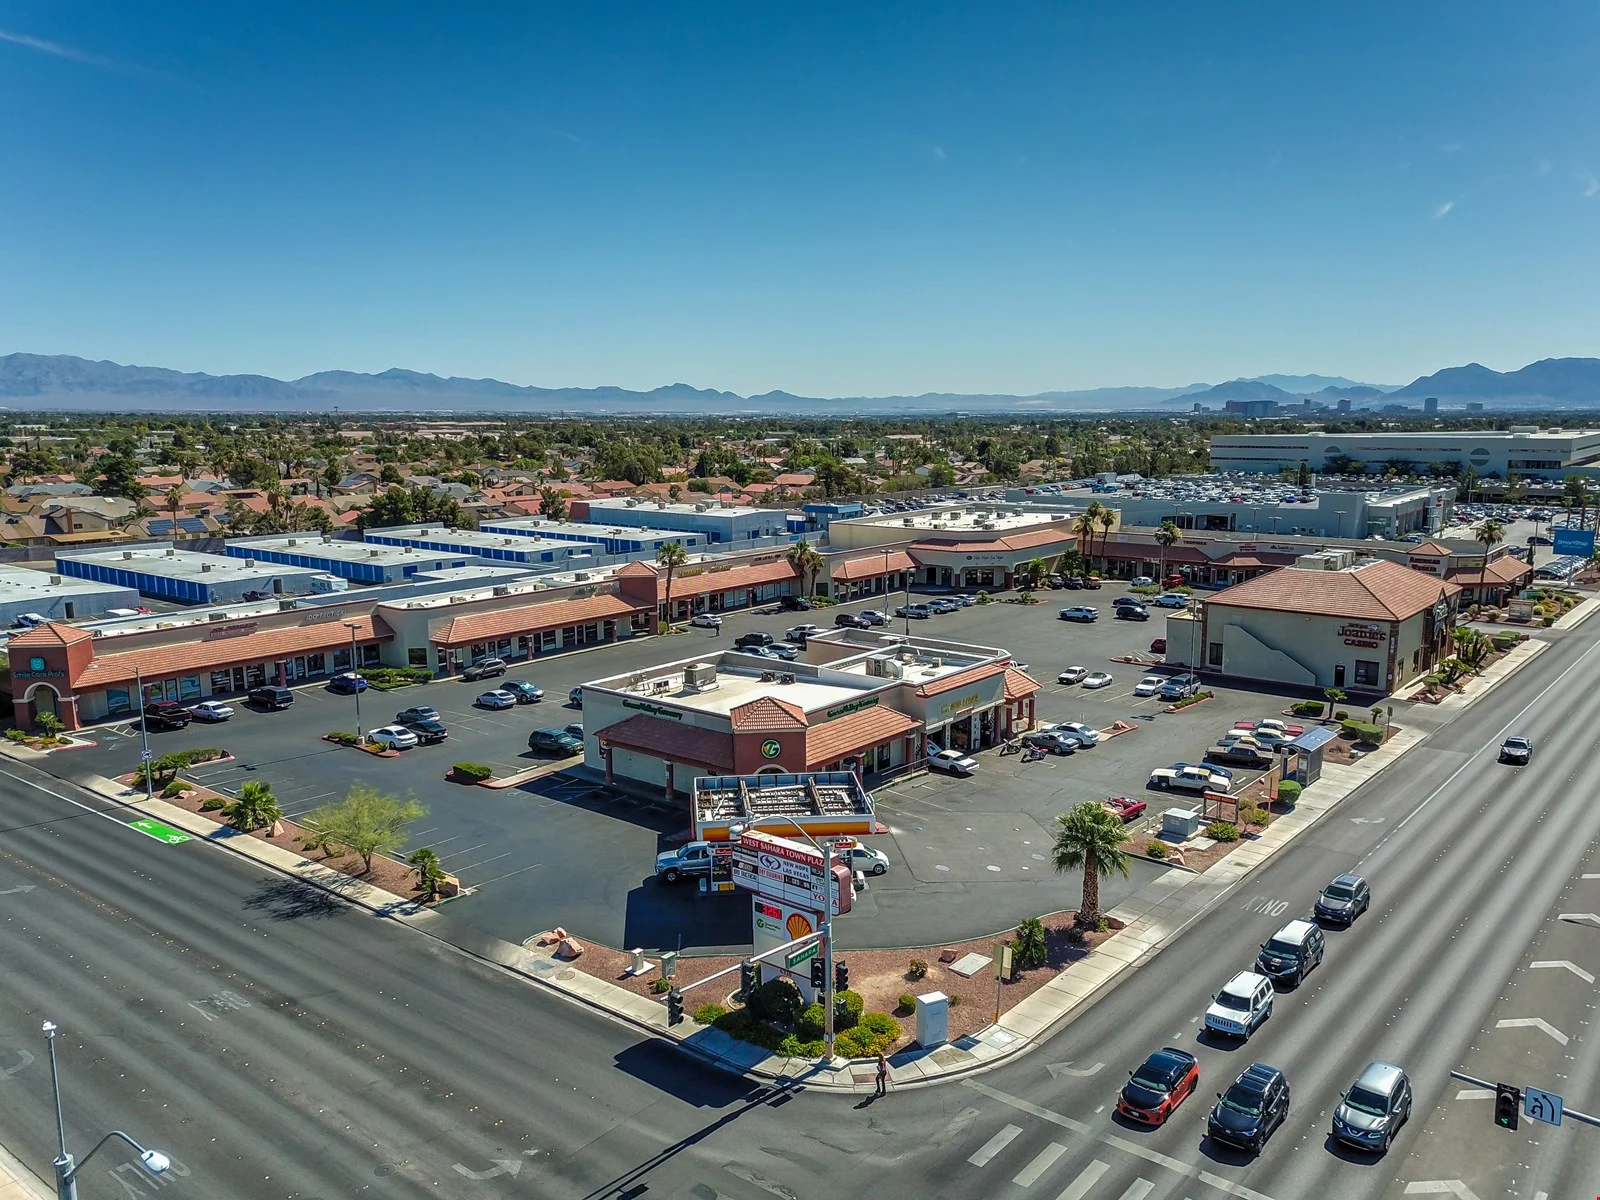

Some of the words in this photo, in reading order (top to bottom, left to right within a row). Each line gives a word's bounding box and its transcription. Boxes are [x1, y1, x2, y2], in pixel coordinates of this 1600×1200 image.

[742, 837, 759, 848] WEST
[760, 842, 785, 855] SAHARA
[785, 849, 807, 861] TOWN
[807, 855, 825, 867] PLAZ
[782, 860, 794, 868] NEW
[795, 864, 809, 873] HOPE
[782, 867, 792, 875] LAS
[793, 870, 810, 880] VEGAS
[792, 948, 817, 964] SAHARA
